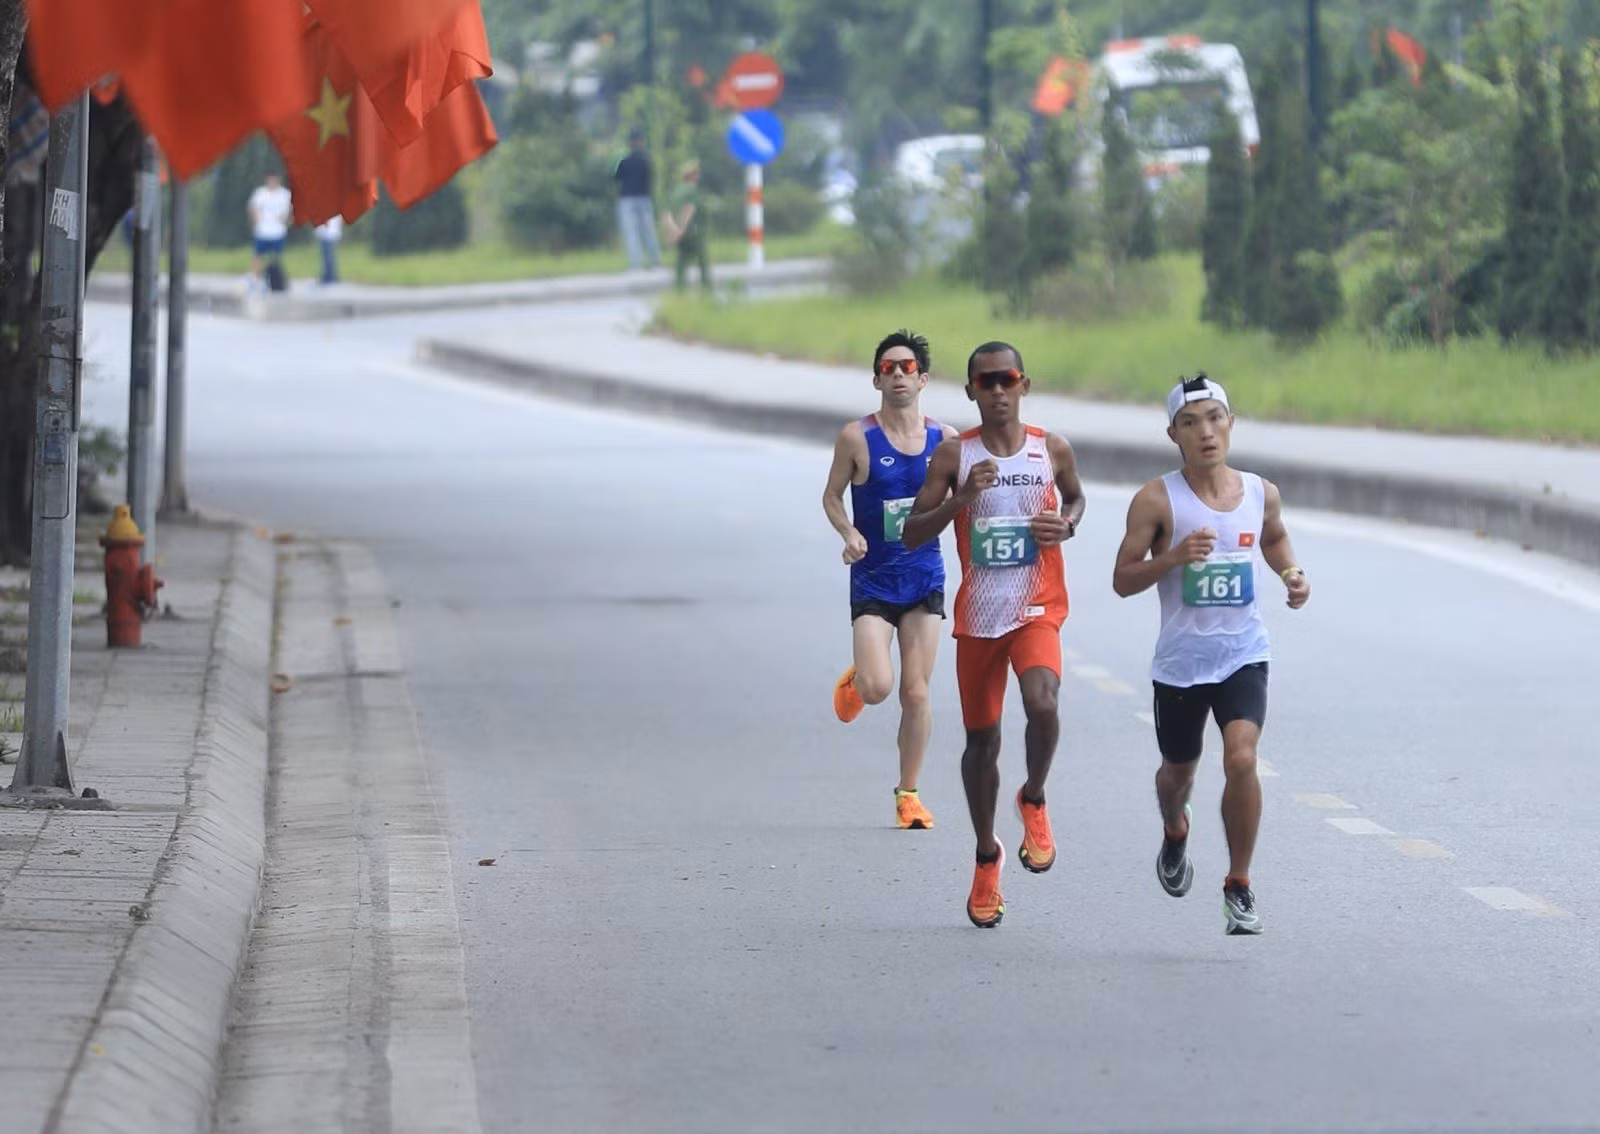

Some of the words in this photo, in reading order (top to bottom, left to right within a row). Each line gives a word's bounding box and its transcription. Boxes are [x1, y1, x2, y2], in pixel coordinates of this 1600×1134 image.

[992, 474, 1044, 488] ONESIA
[982, 538, 1025, 560] 151
[1197, 575, 1241, 598] 161
